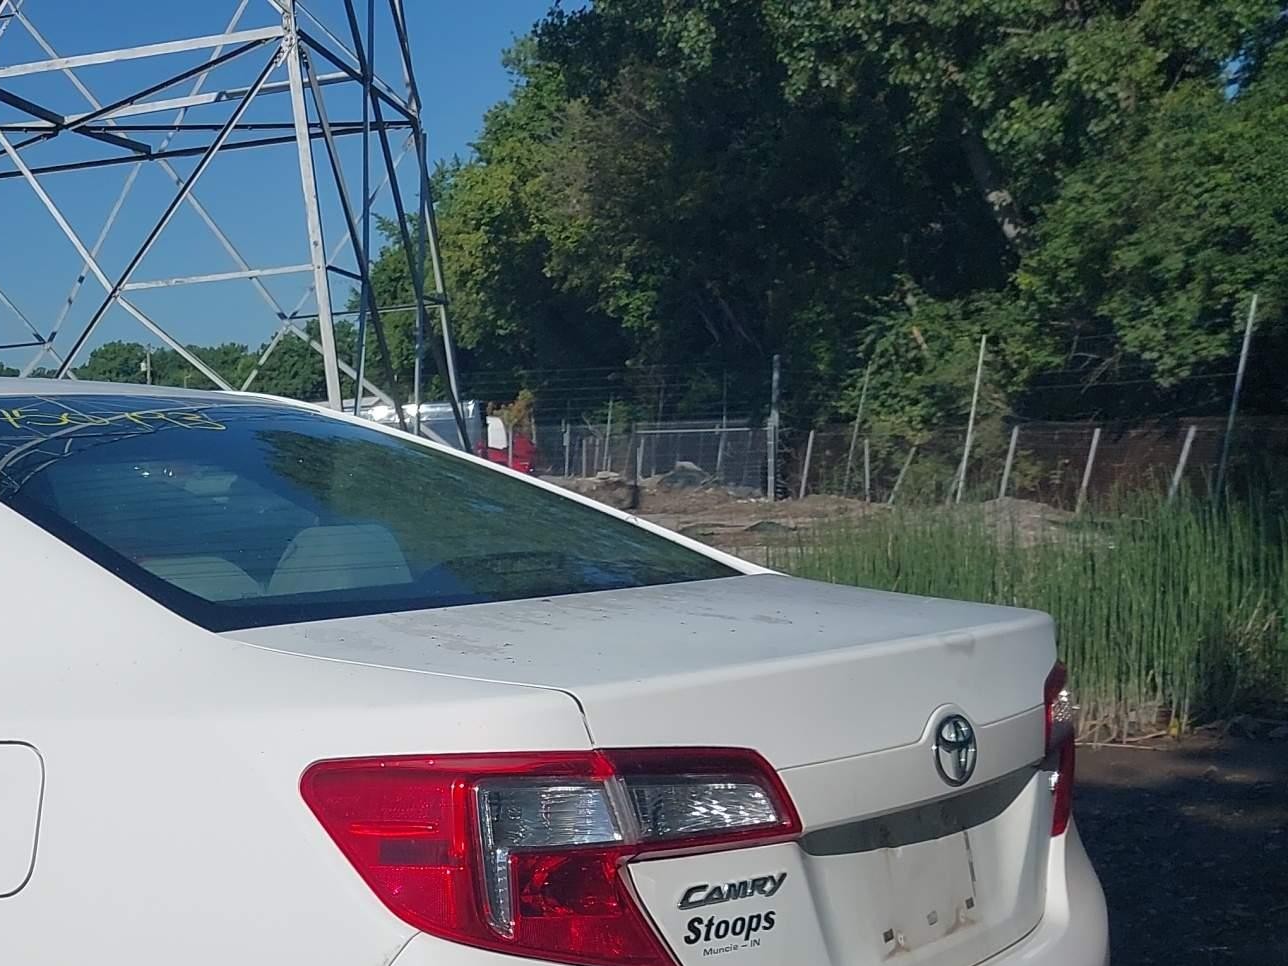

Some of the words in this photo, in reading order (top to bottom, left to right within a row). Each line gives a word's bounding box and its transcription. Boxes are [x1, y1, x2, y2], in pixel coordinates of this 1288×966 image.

[677, 872, 787, 910] CAMRY
[683, 910, 776, 945] Stoops
[703, 943, 739, 957] Muncie
[750, 938, 761, 948] IN
